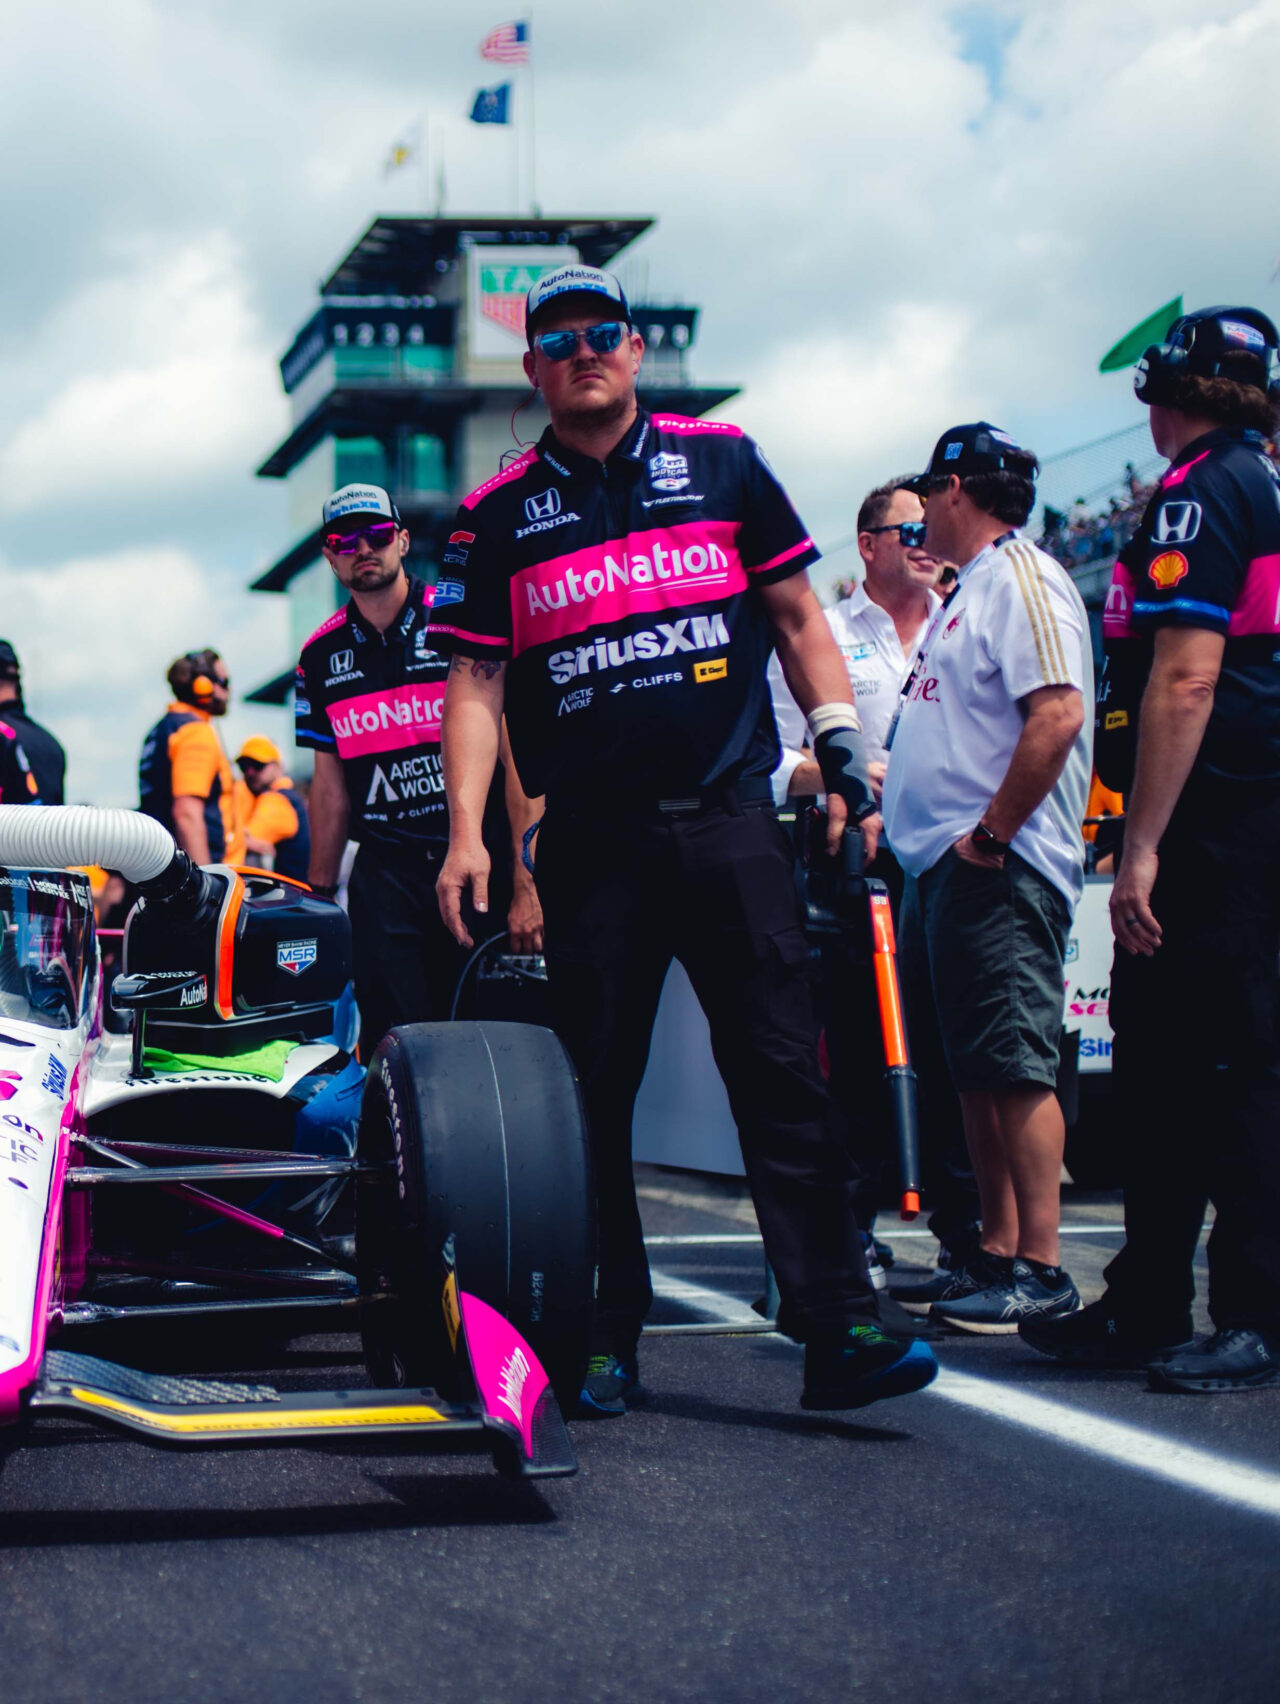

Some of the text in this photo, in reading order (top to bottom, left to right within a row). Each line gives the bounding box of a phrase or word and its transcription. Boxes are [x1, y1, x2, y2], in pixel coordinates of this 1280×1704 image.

[539, 270, 605, 291] AutoNation
[651, 467, 689, 478] INDYCAR
[330, 486, 378, 507] AutoNation
[515, 512, 582, 539] HONDA
[526, 542, 728, 616] AutoNation
[547, 613, 731, 686] SiriusXM
[324, 670, 365, 688] HONDA
[632, 671, 684, 688] CLIFFS
[332, 695, 444, 738] utoNatio
[33, 880, 65, 891] MOBILE
[279, 947, 316, 962] MSR
